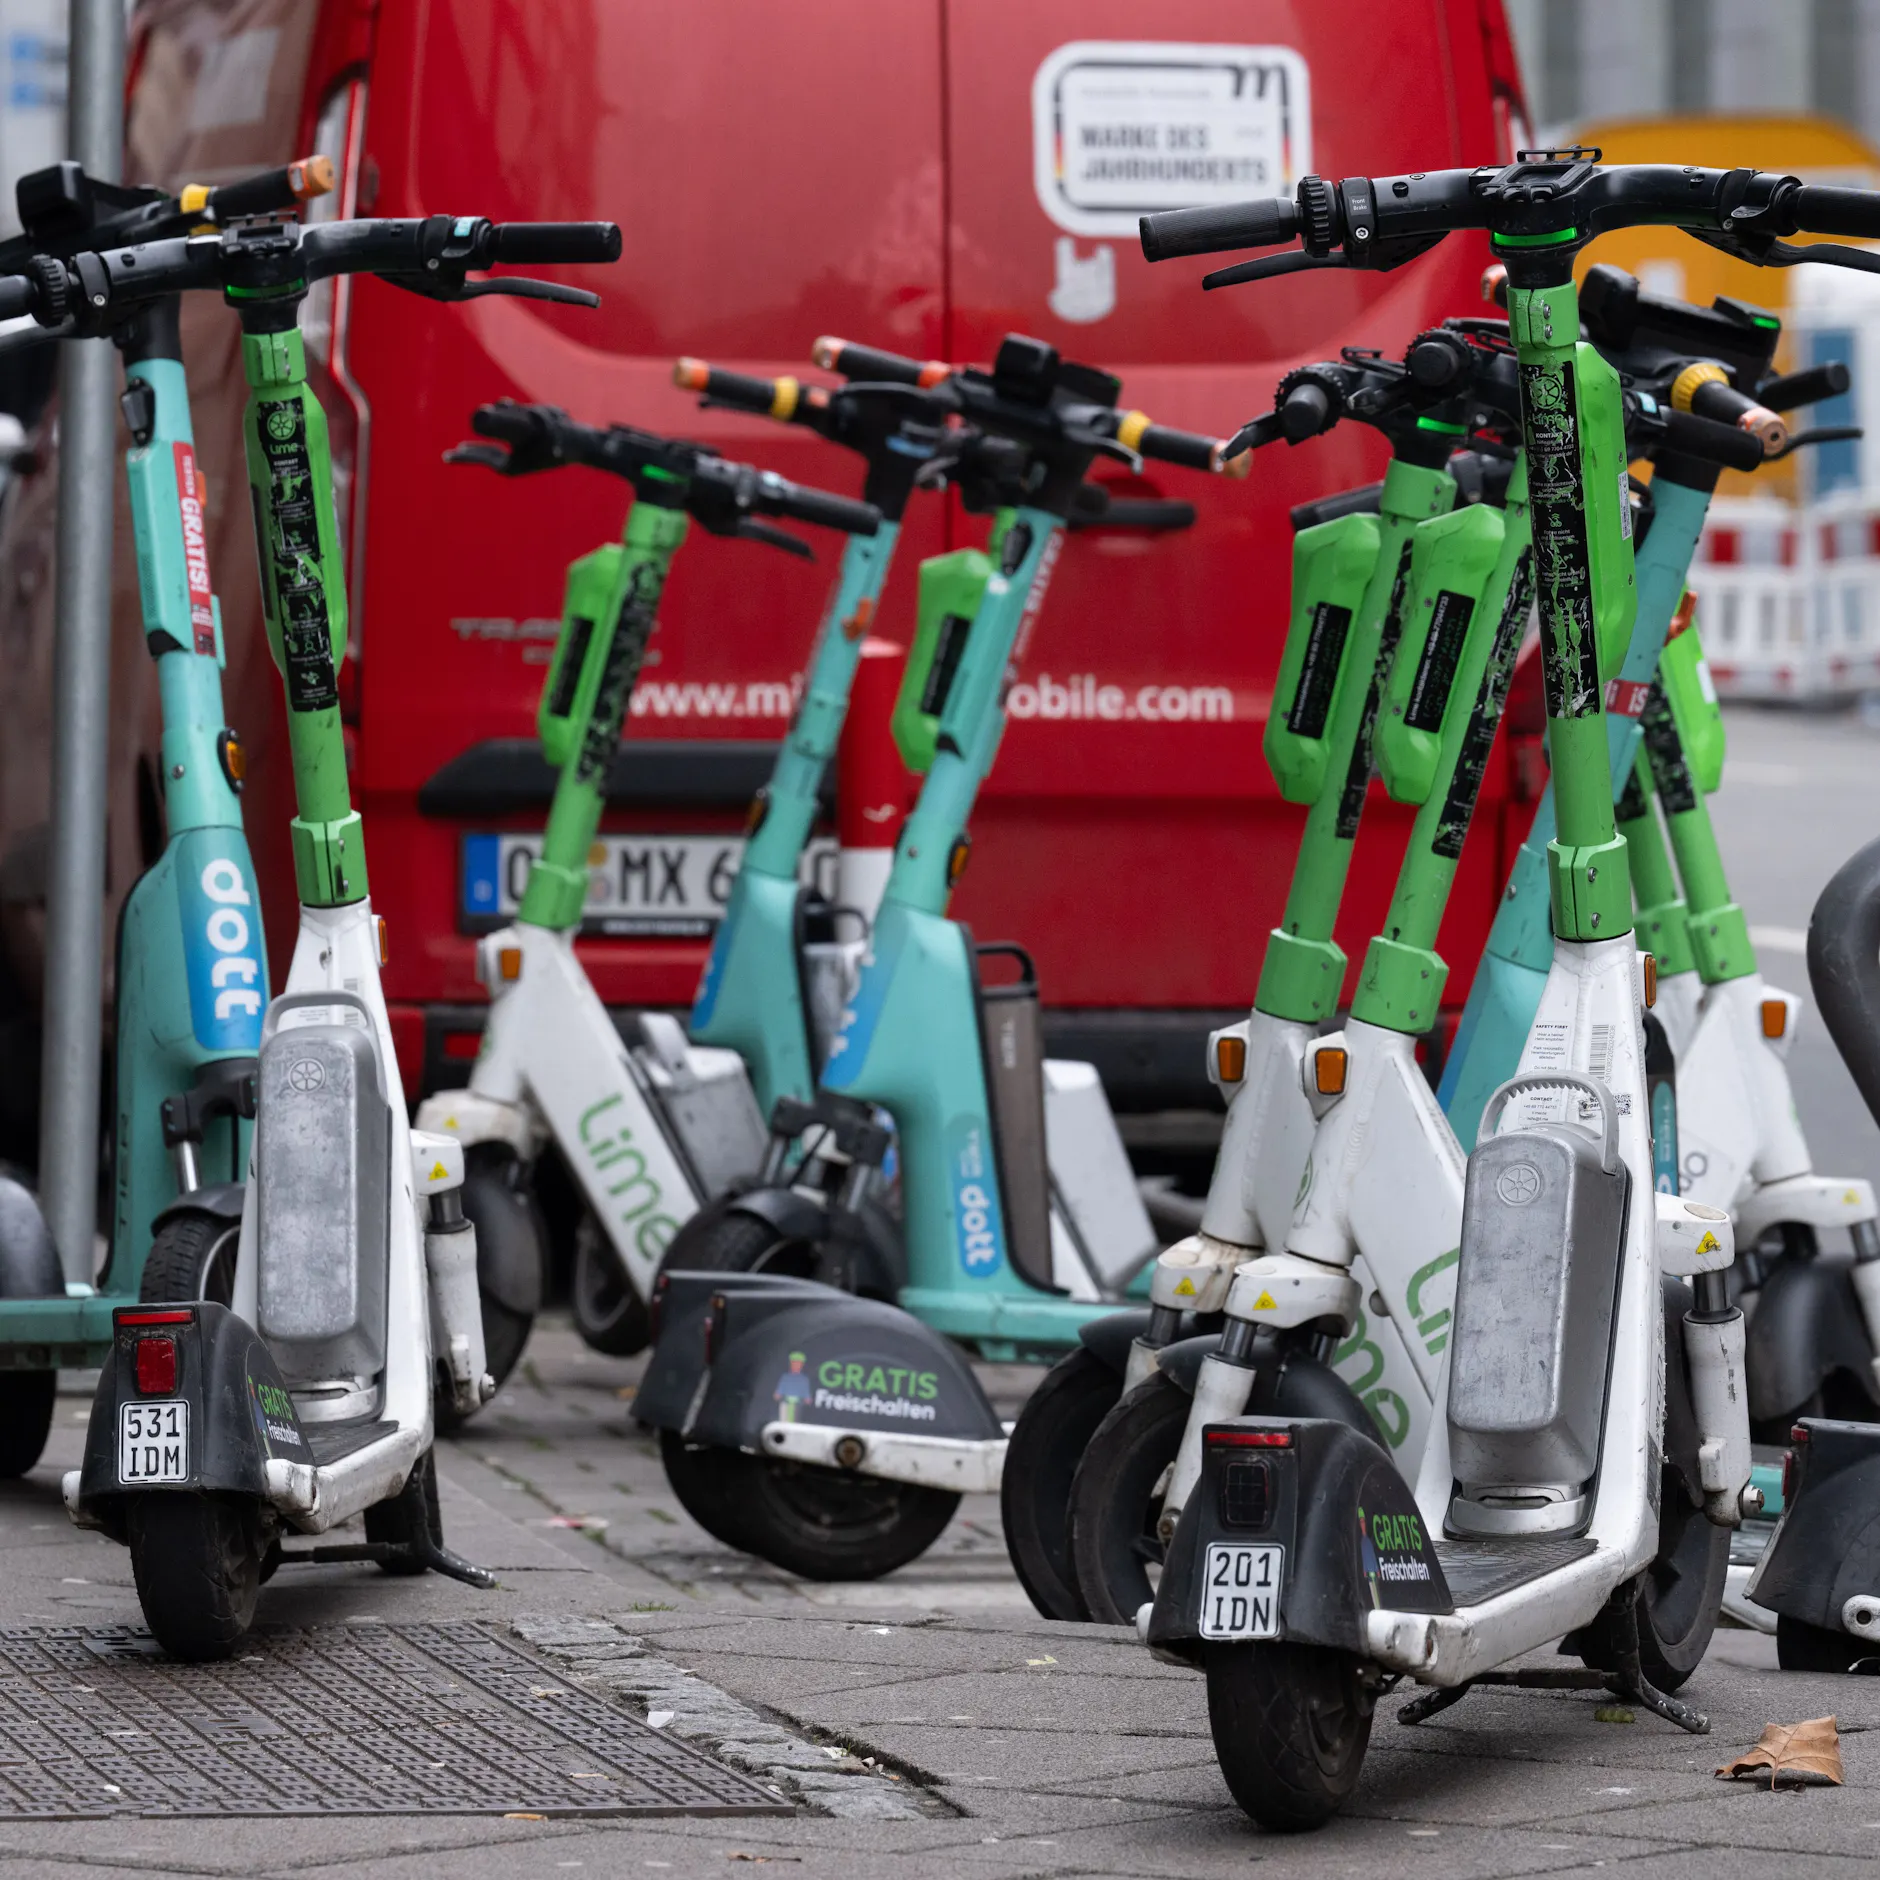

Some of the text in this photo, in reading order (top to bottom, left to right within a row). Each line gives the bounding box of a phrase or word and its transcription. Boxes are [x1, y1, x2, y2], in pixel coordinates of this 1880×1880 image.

[181, 497, 209, 593] GRATIS!
[1006, 672, 1234, 721] obile.com
[620, 848, 687, 905] MX
[202, 858, 262, 1019] dott
[578, 1090, 684, 1262] Lime
[959, 1184, 996, 1267] dott
[817, 1360, 939, 1400] GRATIS
[257, 1383, 293, 1421] GRATIS
[814, 1387, 936, 1421] Freischalten
[127, 1407, 181, 1439] 531
[266, 1418, 302, 1447] Freischalten
[128, 1445, 180, 1477] IDM
[1372, 1514, 1423, 1552] GRATIS
[1212, 1551, 1272, 1588] 201
[1378, 1554, 1431, 1582] Freischalten
[1210, 1596, 1270, 1632] IDN
